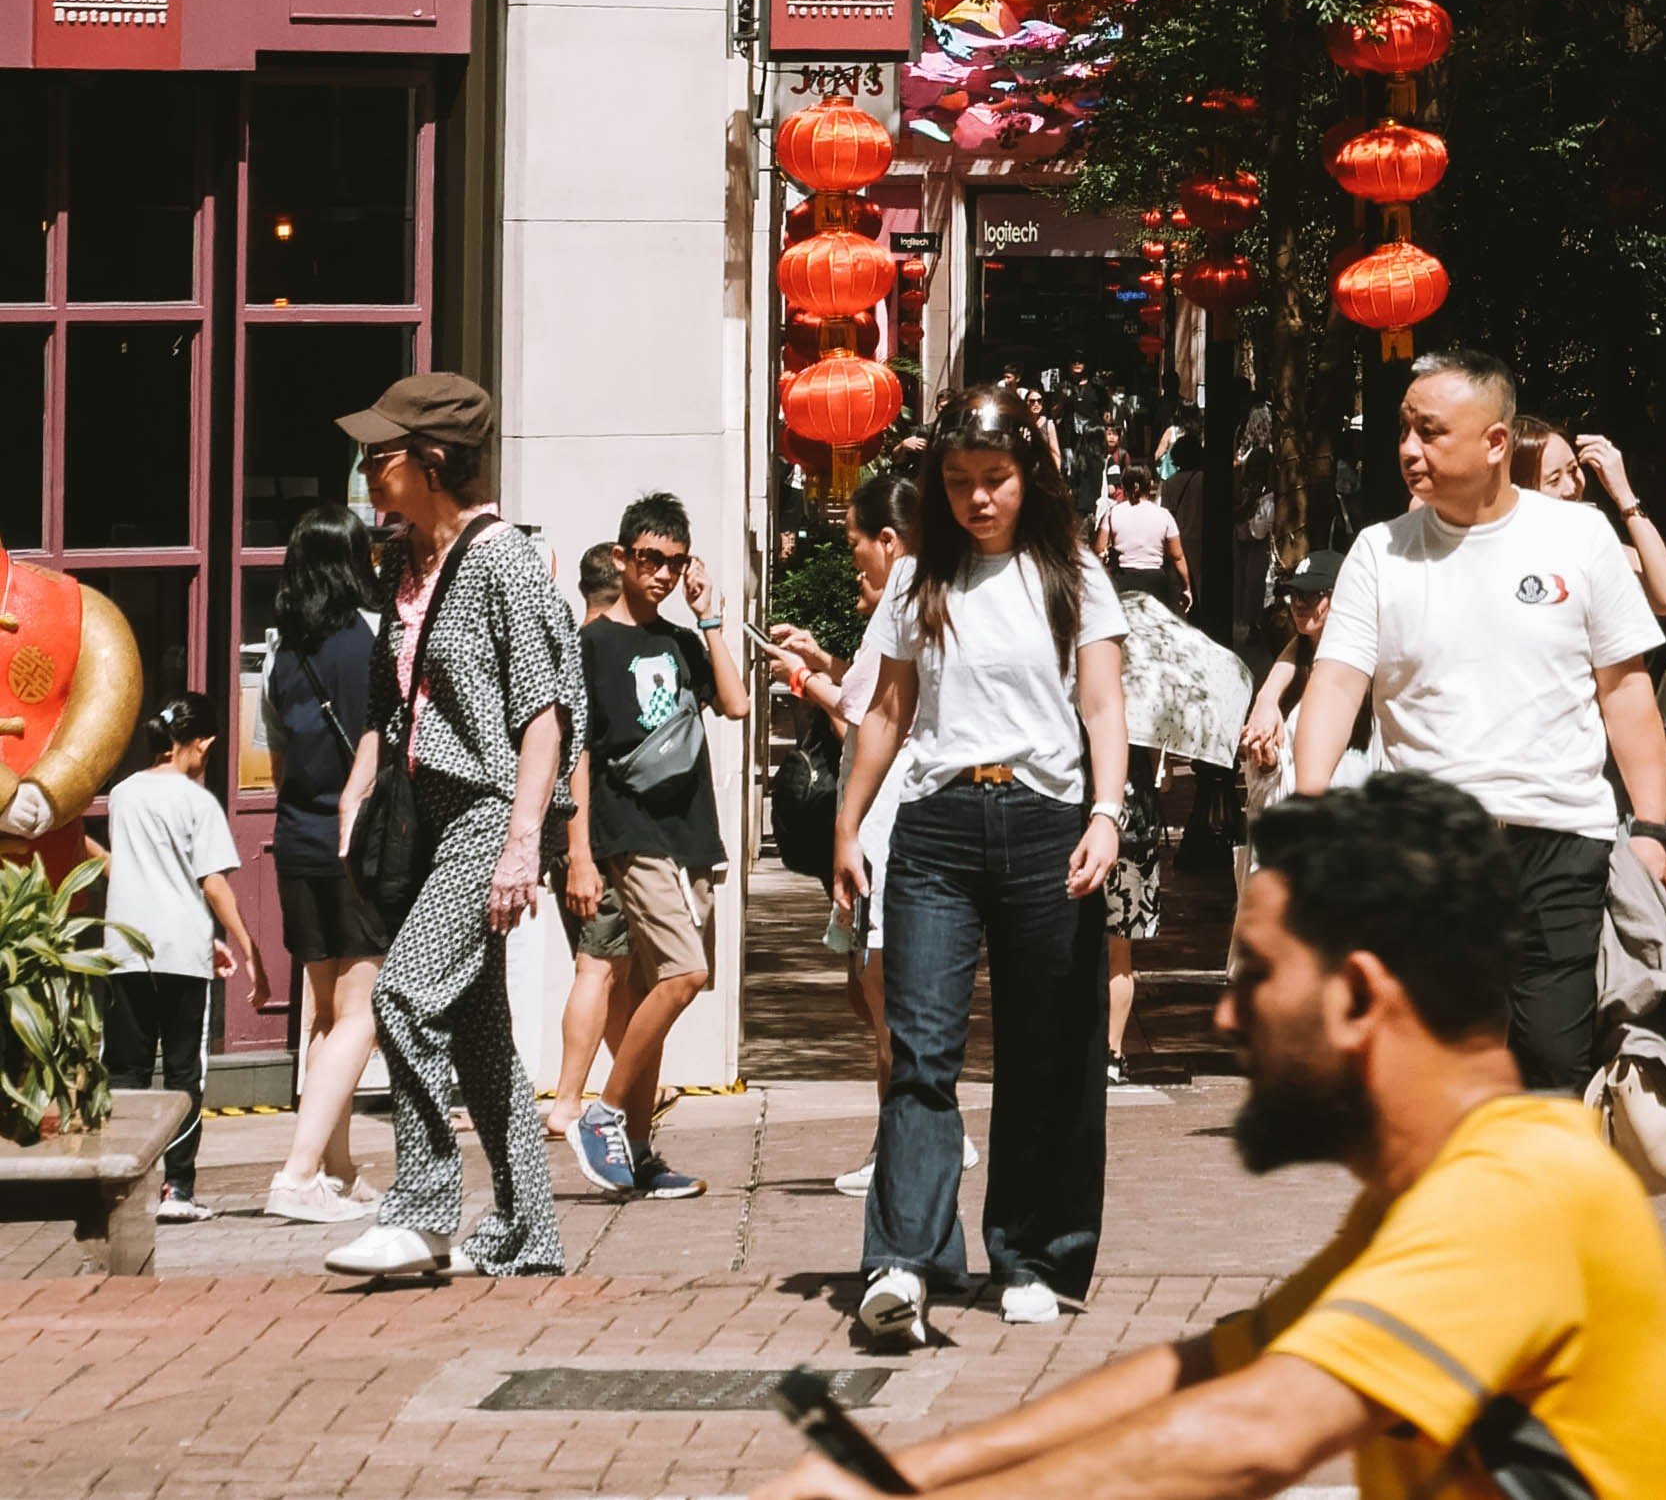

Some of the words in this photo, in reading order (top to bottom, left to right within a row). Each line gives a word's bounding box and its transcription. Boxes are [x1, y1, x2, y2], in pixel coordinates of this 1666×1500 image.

[54, 7, 167, 23] Restaurant
[788, 5, 894, 16] Restaurant
[984, 220, 1037, 250] logitech
[900, 236, 929, 249] logitech
[1115, 290, 1147, 302] logitech
